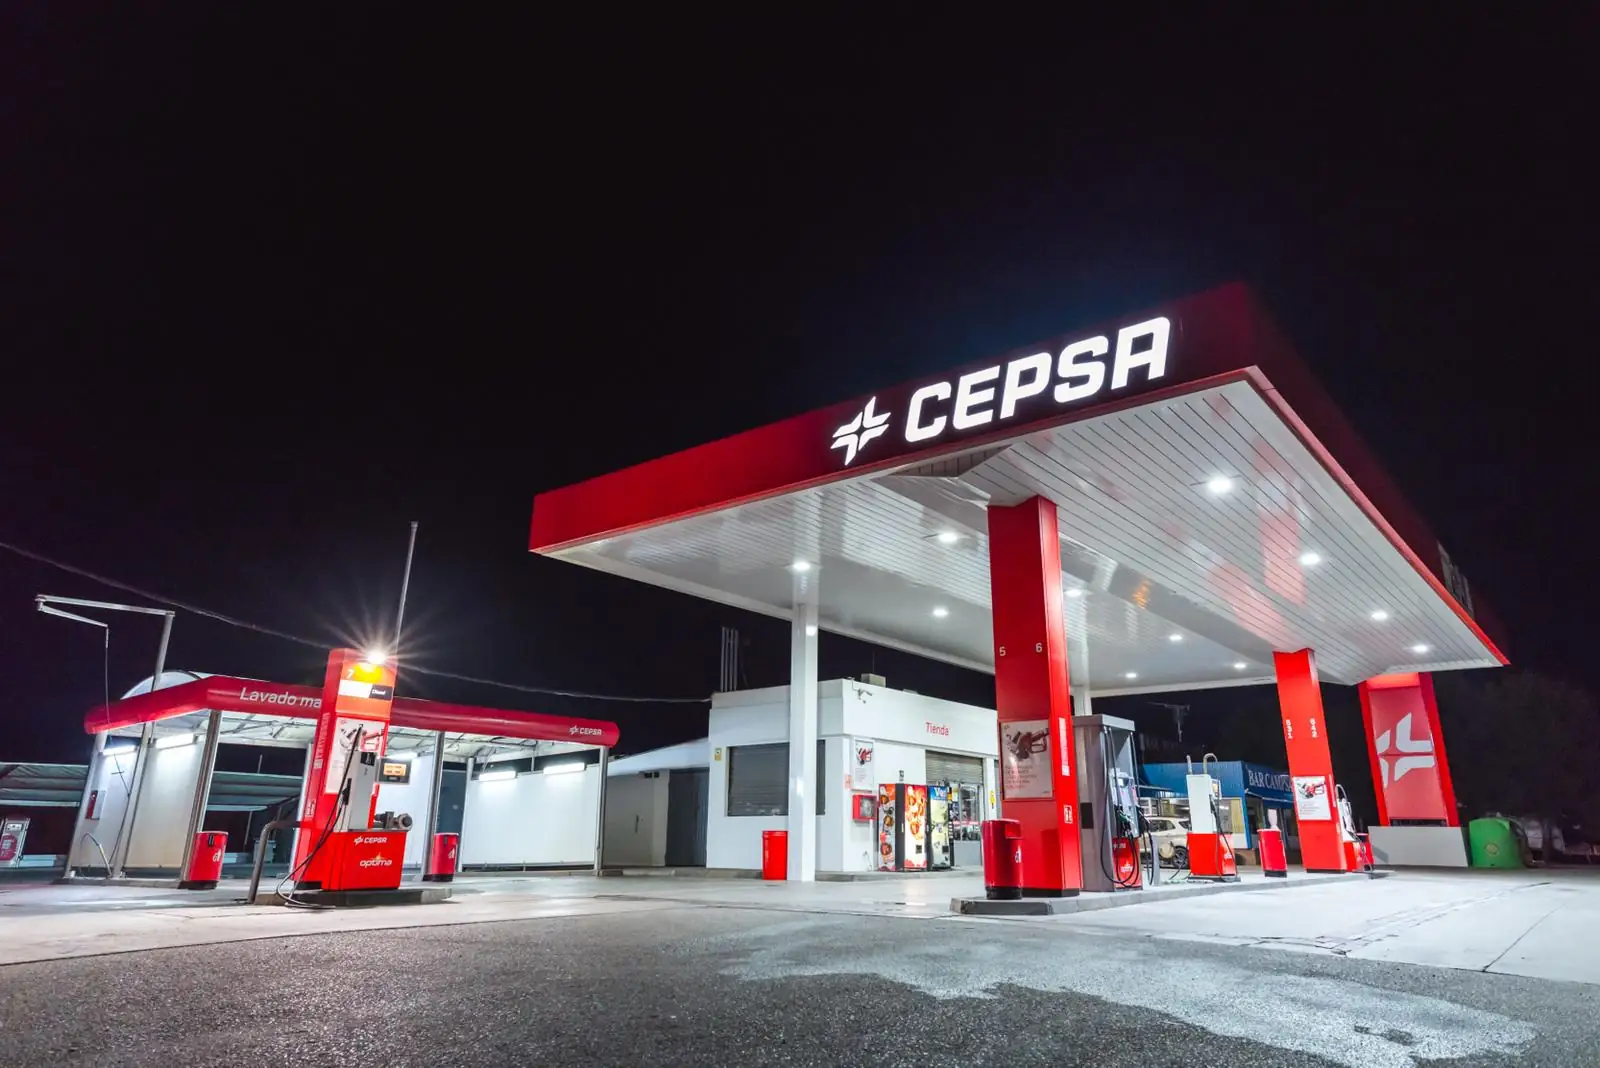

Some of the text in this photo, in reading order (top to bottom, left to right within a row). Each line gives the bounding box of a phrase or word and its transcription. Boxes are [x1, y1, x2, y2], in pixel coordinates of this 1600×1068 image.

[905, 316, 1171, 443] CEPSA
[999, 646, 1007, 657] 5
[1035, 642, 1043, 653] 6
[346, 668, 355, 680] 7
[240, 687, 297, 706] Lavado
[579, 727, 602, 736] CEPSA
[925, 721, 949, 736] Tienda
[1248, 770, 1265, 788] BAR
[363, 836, 387, 844] CEPSA
[359, 858, 393, 869] optima
